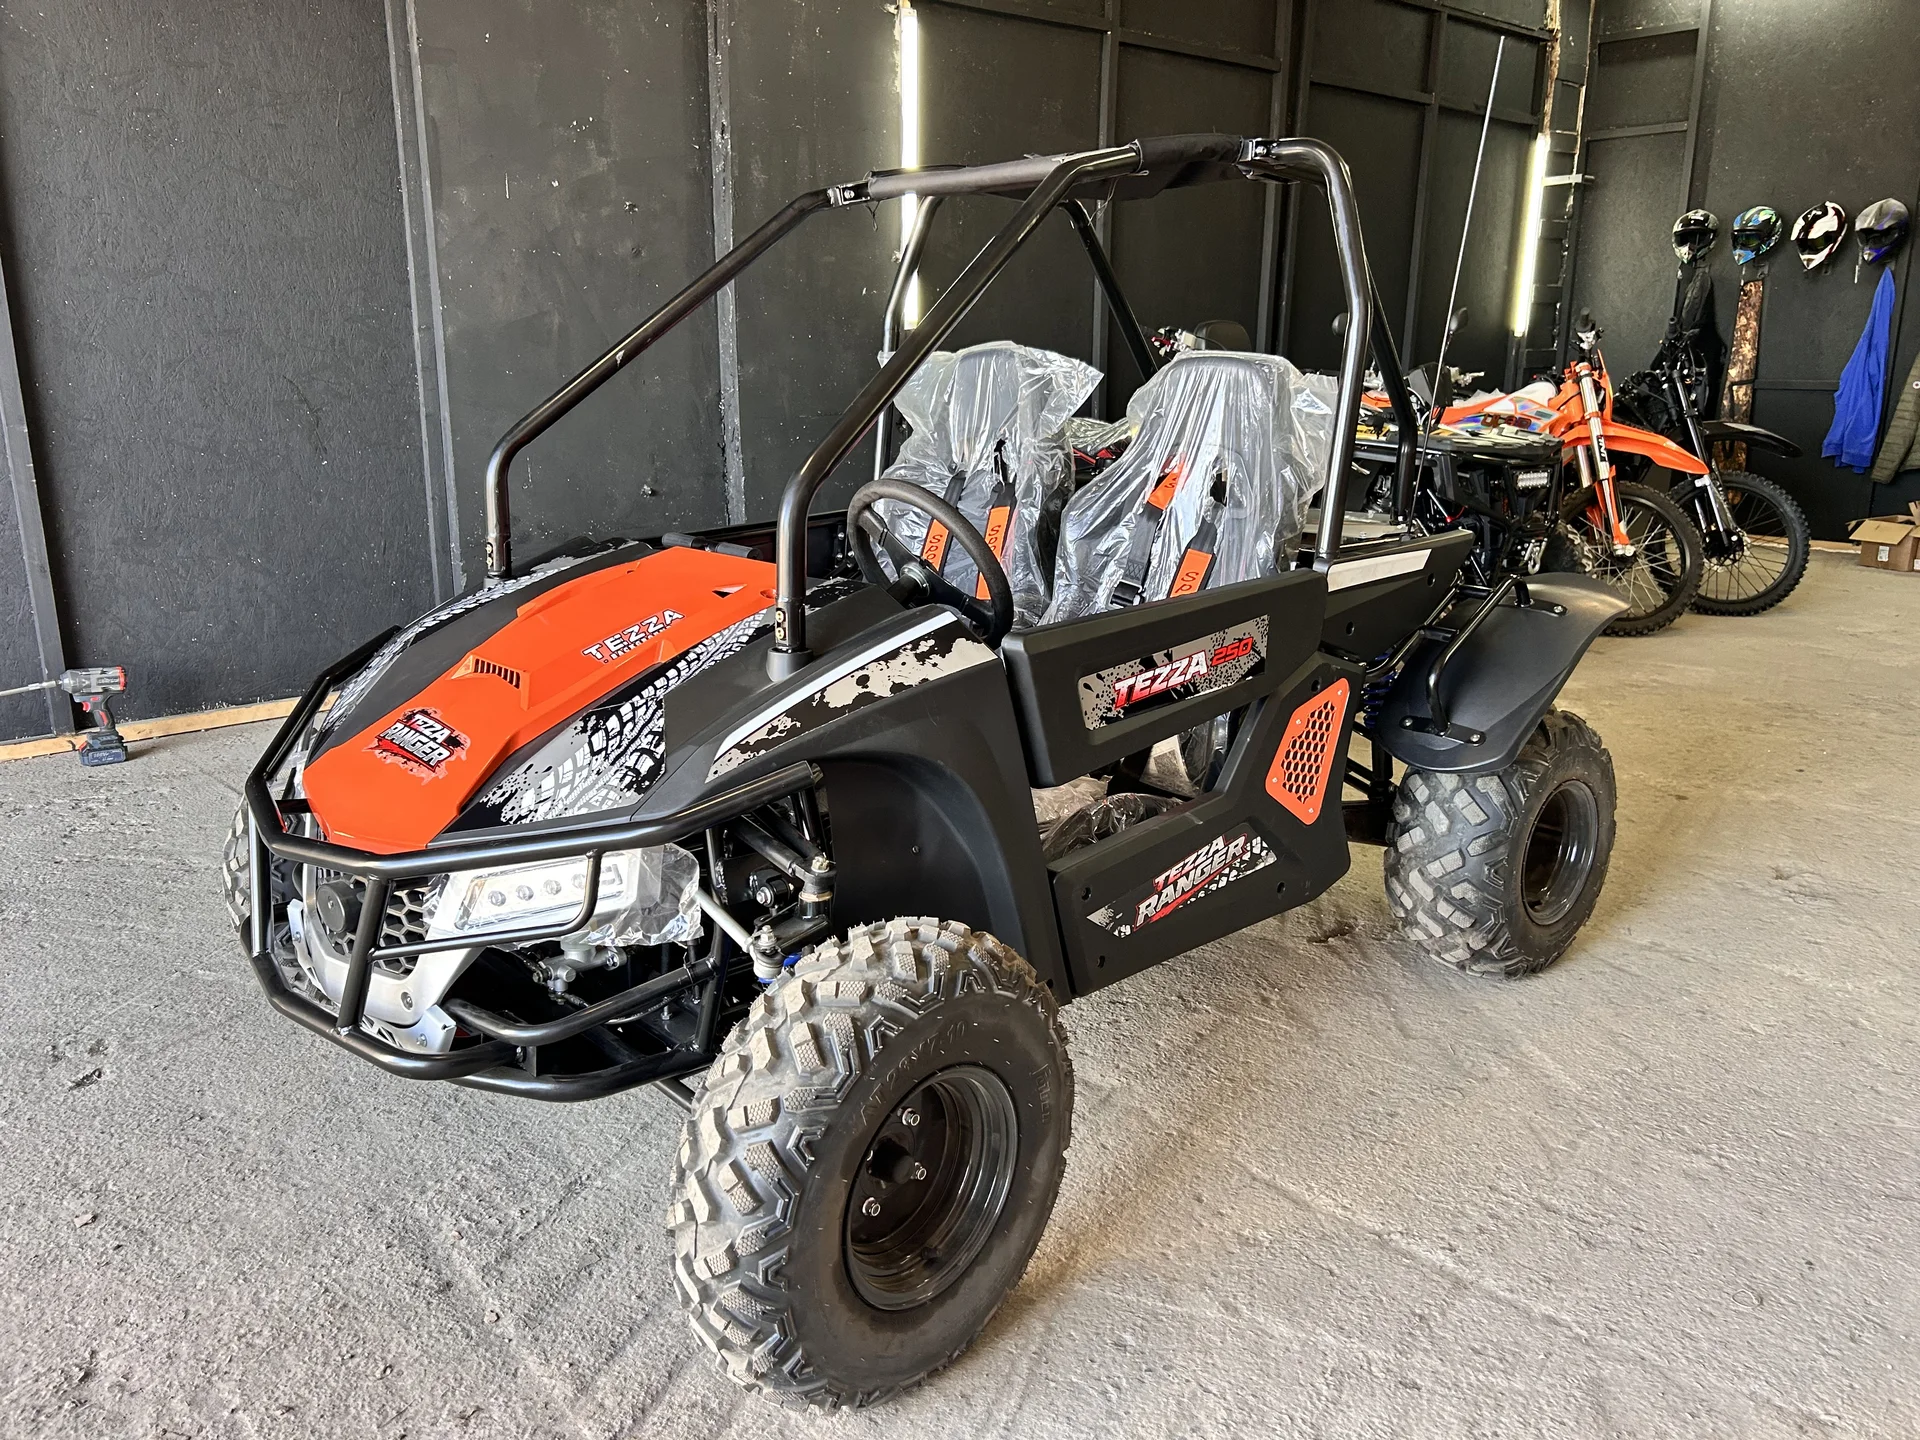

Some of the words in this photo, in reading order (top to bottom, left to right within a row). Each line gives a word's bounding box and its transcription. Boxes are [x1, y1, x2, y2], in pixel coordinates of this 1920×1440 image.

[582, 608, 685, 660] TEZZA
[1114, 650, 1208, 710] TEZZA
[1211, 636, 1253, 667] 250
[379, 721, 452, 767] RANGER
[407, 712, 453, 744] TEZZA
[1135, 834, 1247, 928] RANGER
[1153, 835, 1226, 891] TEZZA
